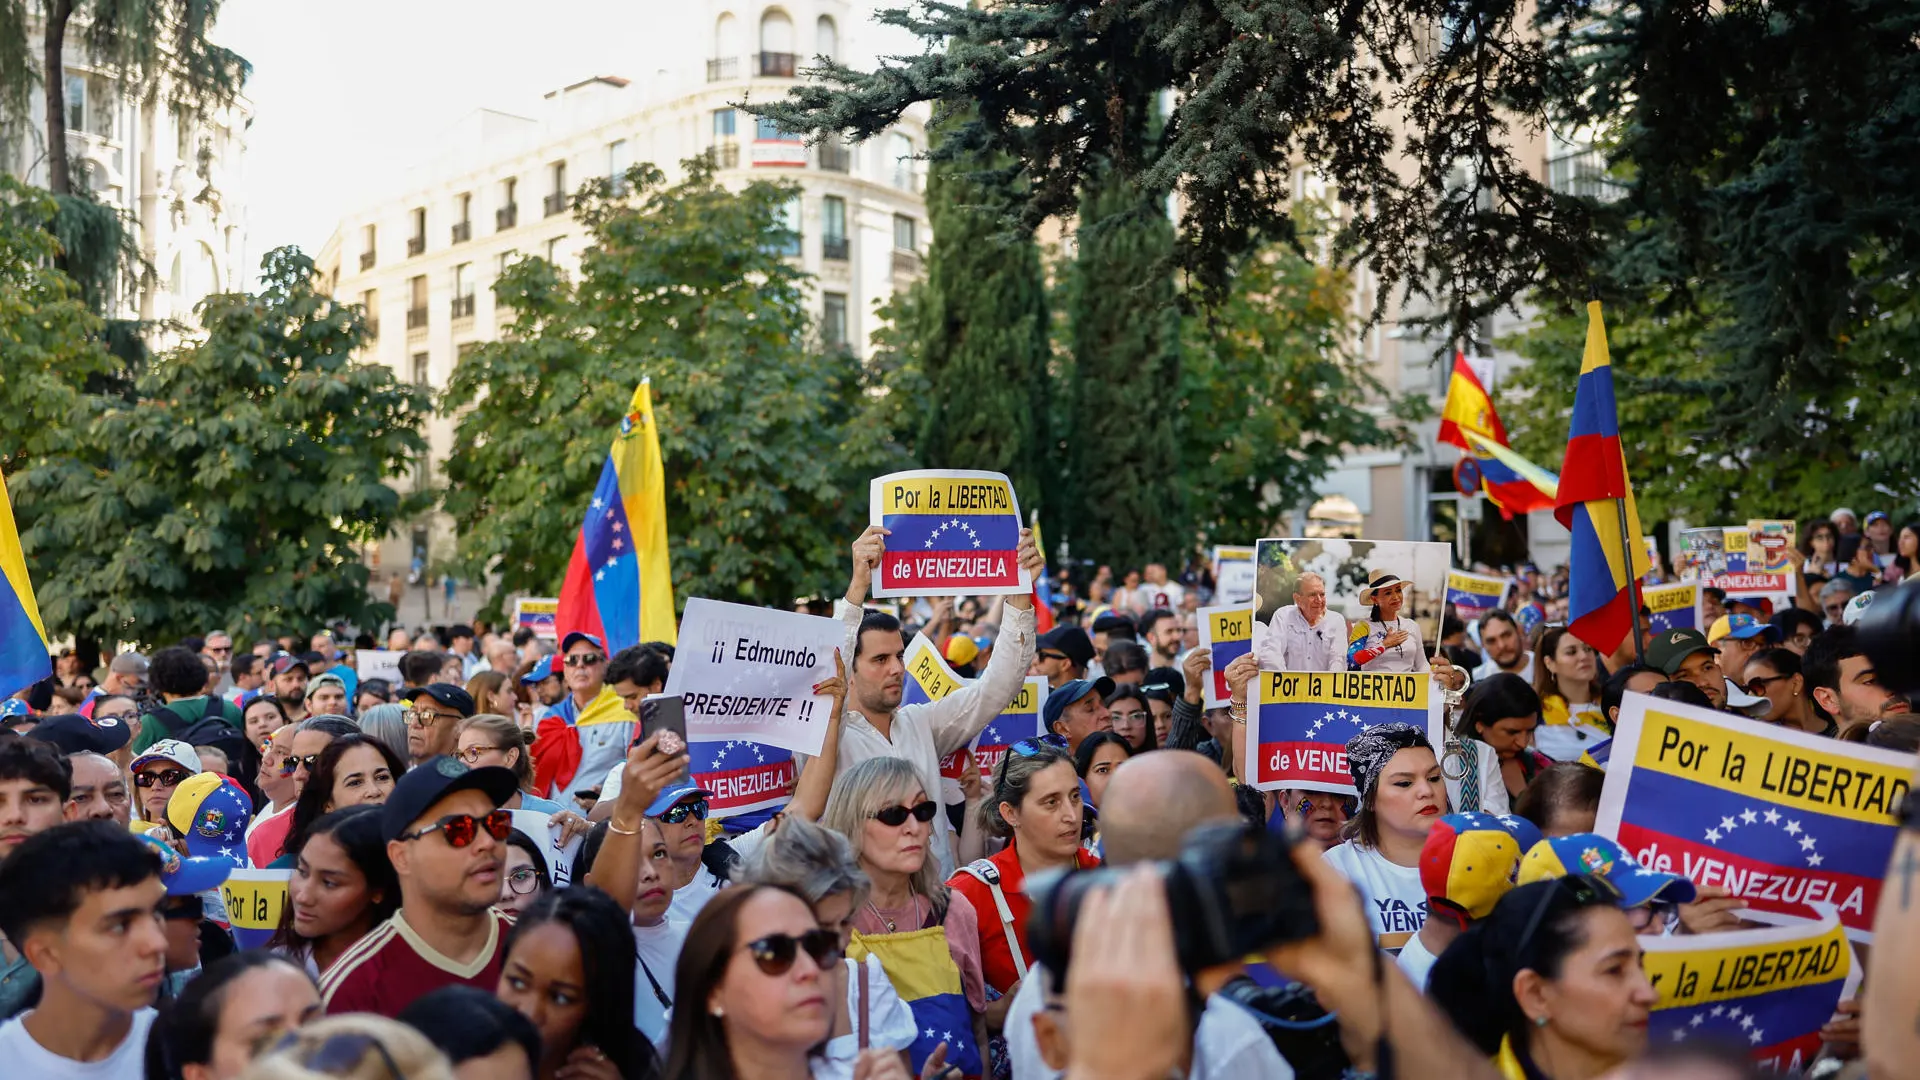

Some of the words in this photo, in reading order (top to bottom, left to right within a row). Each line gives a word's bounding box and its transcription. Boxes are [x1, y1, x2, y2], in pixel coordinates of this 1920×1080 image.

[894, 486, 921, 509] Por
[929, 485, 941, 508] la
[947, 485, 1008, 509] LIBERTAD
[892, 559, 911, 579] de
[915, 557, 1007, 579] VENEZUELA
[1712, 574, 1779, 588] VENEZUELA
[1651, 589, 1692, 610] LIBERTAD
[1220, 617, 1242, 637] Por
[735, 638, 816, 668] Edmundo
[916, 656, 932, 684] Por
[930, 673, 941, 695] la
[1272, 672, 1299, 697] Por
[1308, 672, 1322, 697] la
[1332, 673, 1416, 702] LIBERTAD
[683, 692, 792, 717] PRESIDENTE
[798, 700, 814, 722] !!
[1006, 689, 1029, 709] AD
[1270, 750, 1290, 771] de
[1295, 749, 1352, 774] VENE
[1658, 726, 1709, 771] Por
[1721, 742, 1746, 783] la
[1760, 752, 1909, 816] LIBERTAD
[704, 770, 784, 799] VENEZUELA
[554, 860, 570, 885] TE
[1637, 843, 1672, 874] de
[1683, 852, 1864, 915] VENEZUELA
[225, 887, 245, 920] Por
[253, 889, 268, 921] la
[1373, 898, 1411, 911] YA
[1380, 912, 1426, 932] VENE
[1674, 962, 1699, 999] la
[1711, 939, 1841, 994] LIBERTAD
